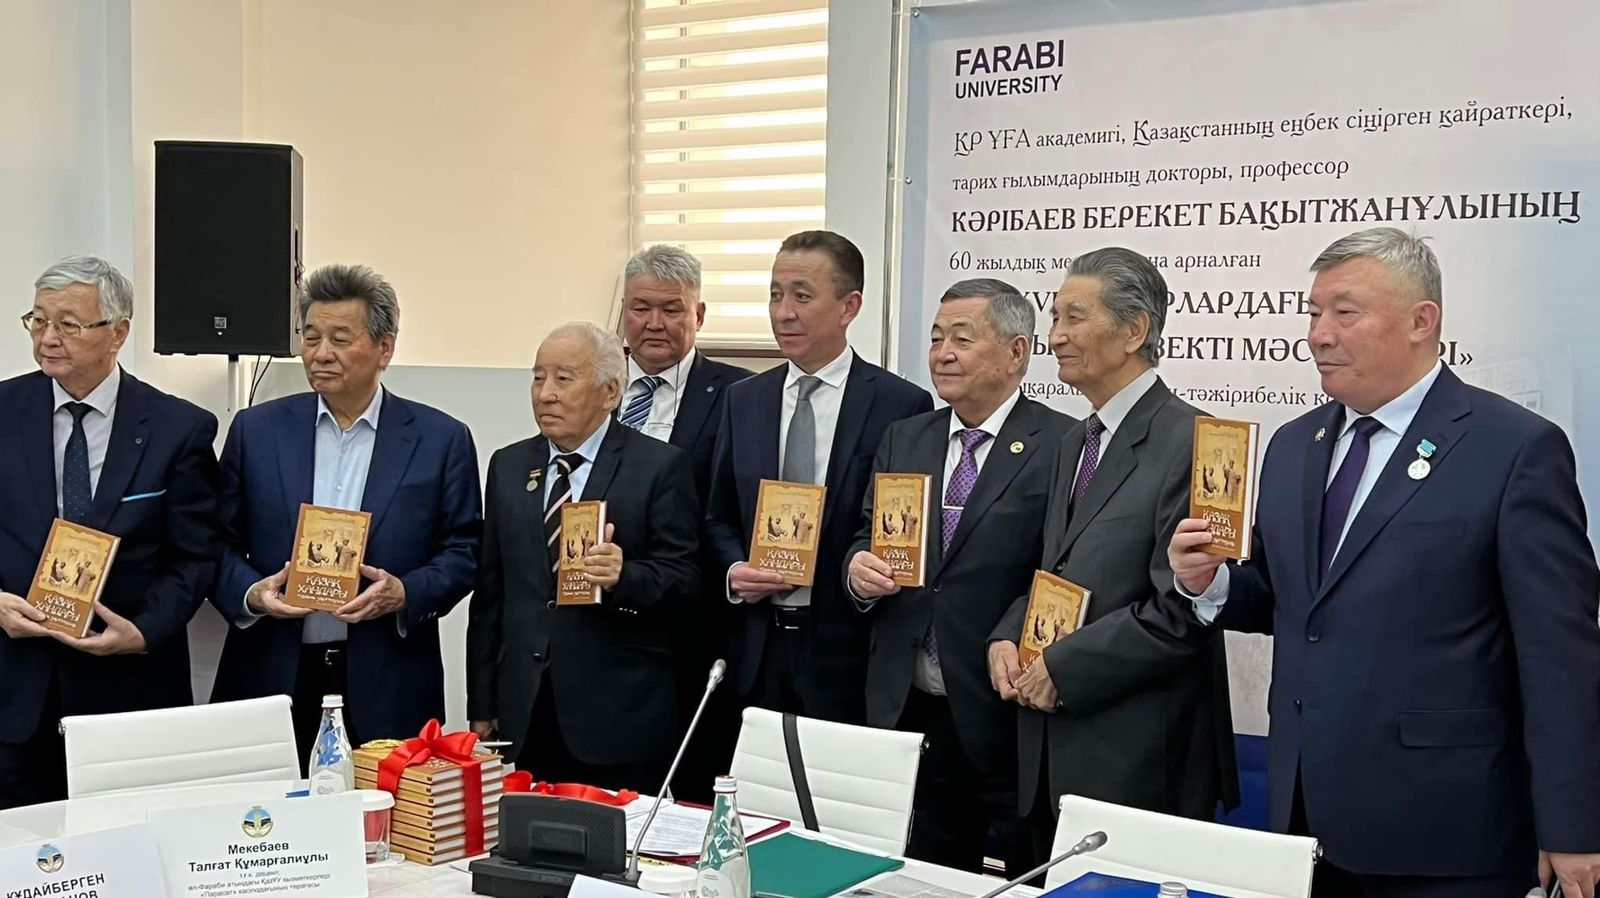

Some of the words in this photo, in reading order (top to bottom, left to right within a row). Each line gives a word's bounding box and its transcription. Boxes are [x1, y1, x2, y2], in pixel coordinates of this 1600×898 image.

[955, 39, 1064, 76] FARABI
[955, 74, 1062, 99] UNIVERSITY
[1036, 124, 1126, 148] академигі,
[1133, 119, 1275, 147] Қазақстанның
[1280, 112, 1340, 137] еңбек
[1346, 107, 1432, 133] сіңірген
[1439, 96, 1573, 128] қайраткері,
[952, 175, 998, 194] тарих
[1002, 170, 1140, 188] ғылымдарының
[1145, 166, 1233, 185] докторы,
[1240, 160, 1349, 182] профессор
[952, 208, 1076, 232] КӘРІБАЕВ
[1083, 202, 1212, 229] БЕРЕКЕТ
[1218, 191, 1581, 231] БАҚЫТЖАНҰЛЫНЫҢ
[949, 251, 971, 270] 60
[976, 257, 1047, 274] жылдық
[1174, 253, 1261, 273] арналған
[1154, 336, 1234, 361] ЗЕКТІ
[227, 842, 290, 855] Мекебаев
[188, 860, 231, 873] Талғат
[234, 852, 329, 870] Құмарғалиұлы
